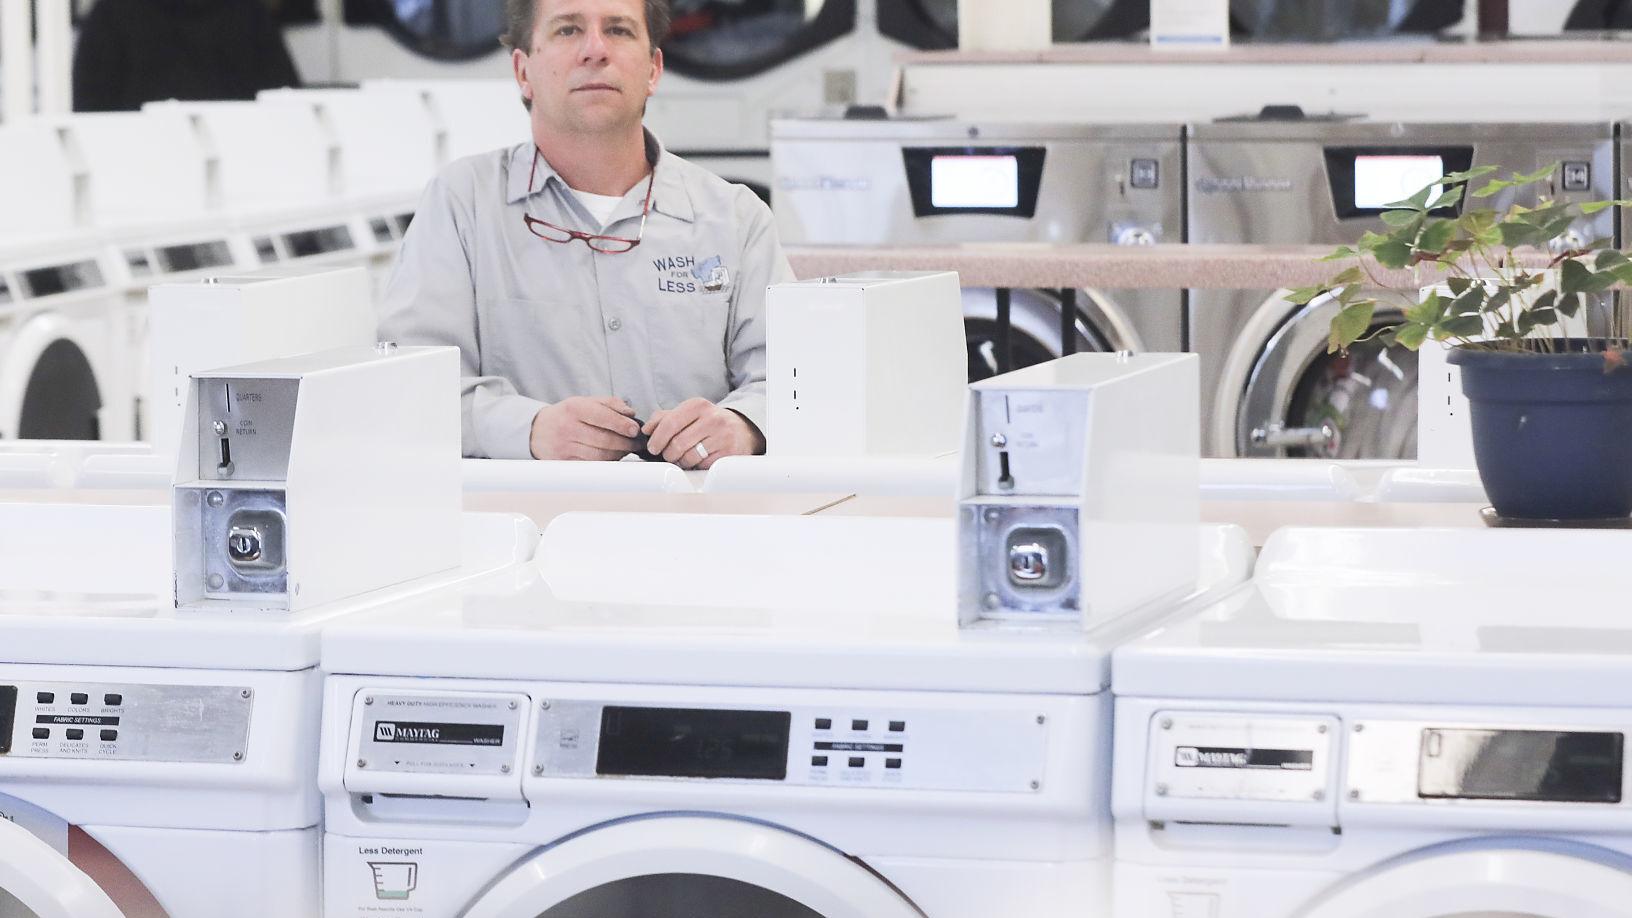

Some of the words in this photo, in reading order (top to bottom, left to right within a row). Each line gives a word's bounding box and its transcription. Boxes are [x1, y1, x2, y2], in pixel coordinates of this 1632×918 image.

[653, 256, 695, 271] WASH
[658, 277, 696, 293] LESS
[235, 392, 262, 402] QUARTERS
[395, 728, 440, 739] MAYTAG
[381, 847, 423, 856] Detergent
